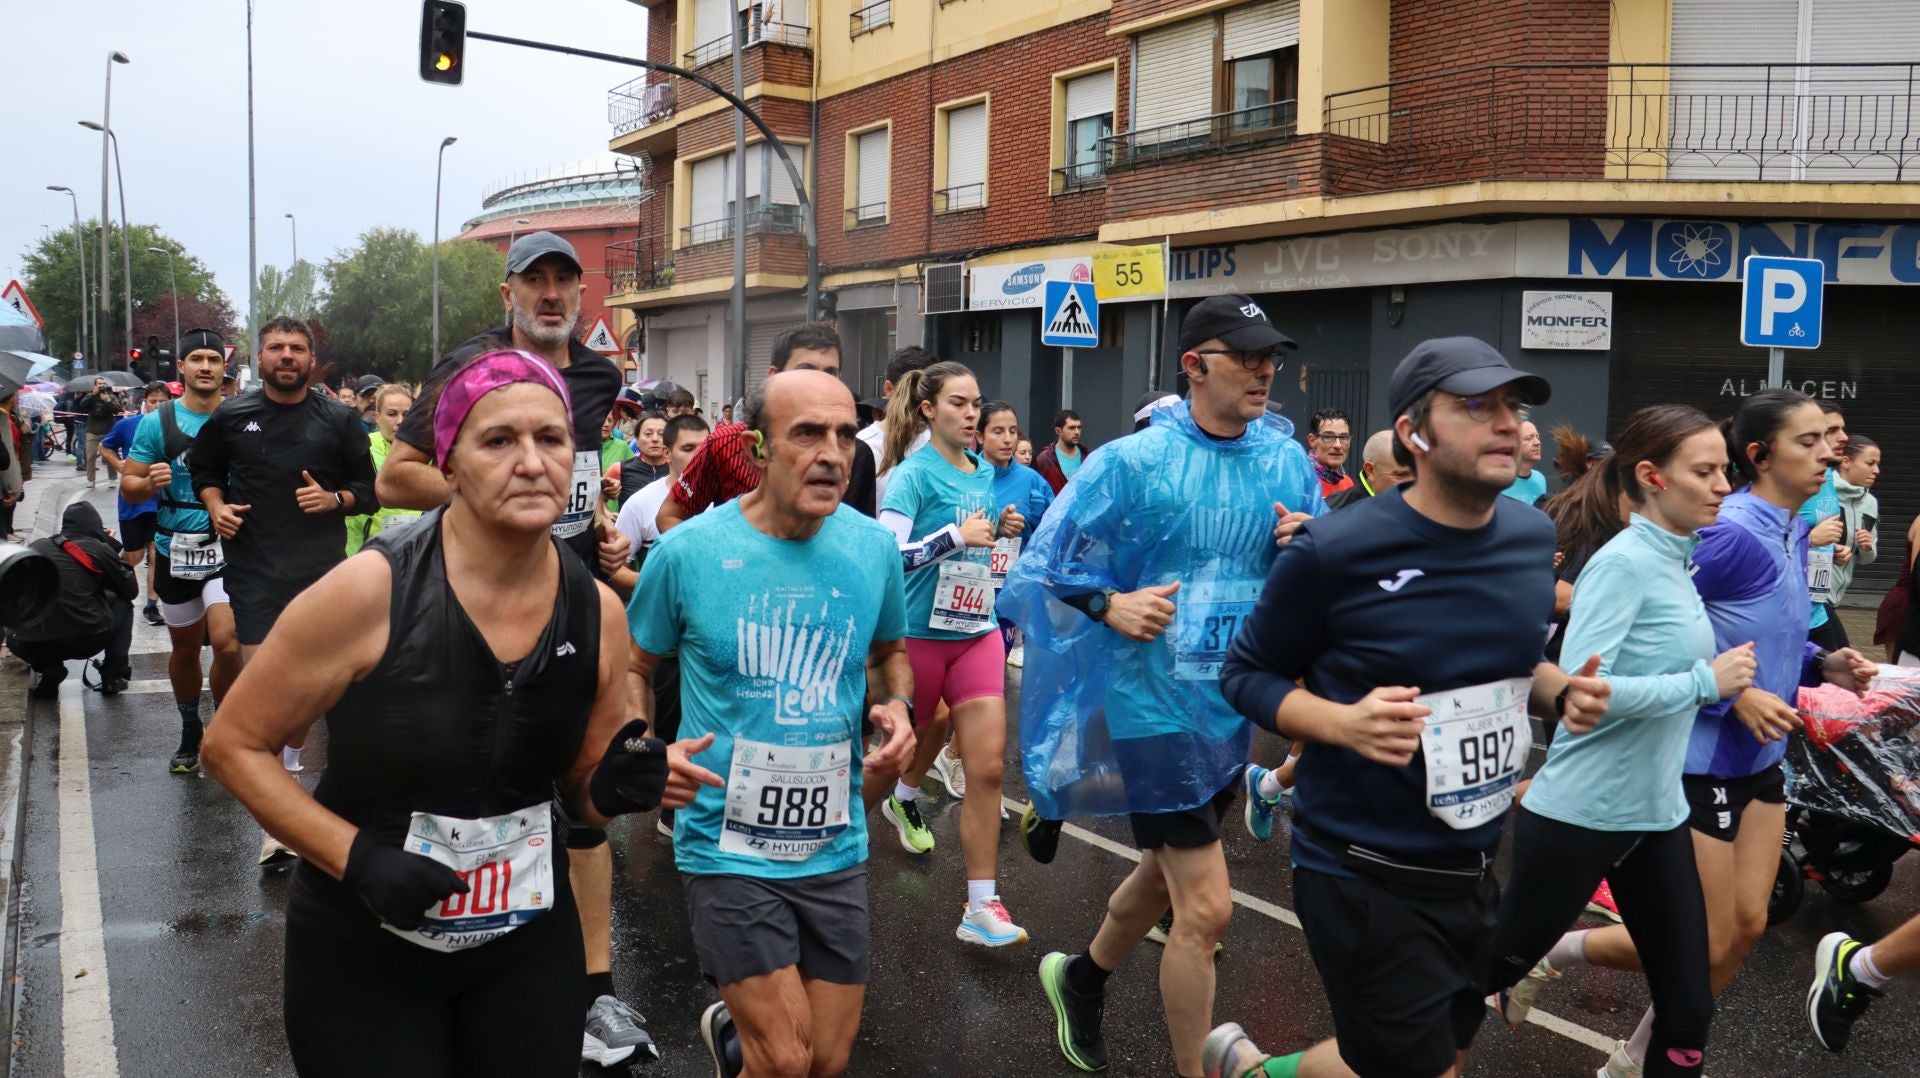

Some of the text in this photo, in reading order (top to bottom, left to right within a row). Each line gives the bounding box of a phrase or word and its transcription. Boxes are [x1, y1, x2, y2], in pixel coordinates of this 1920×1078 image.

[1263, 238, 1340, 275] JVC
[1373, 229, 1497, 264] SONY
[1568, 218, 1920, 284] MONF
[1116, 262, 1143, 287] 55
[1257, 274, 1351, 291] TECNICA
[971, 297, 1036, 309] SERVICIO
[1760, 267, 1808, 336] P
[1527, 315, 1609, 328] MONFER
[185, 548, 217, 566] 1178
[950, 585, 984, 613] 944
[1204, 613, 1249, 652] 37
[1459, 726, 1514, 786] 992
[757, 785, 829, 827] 988
